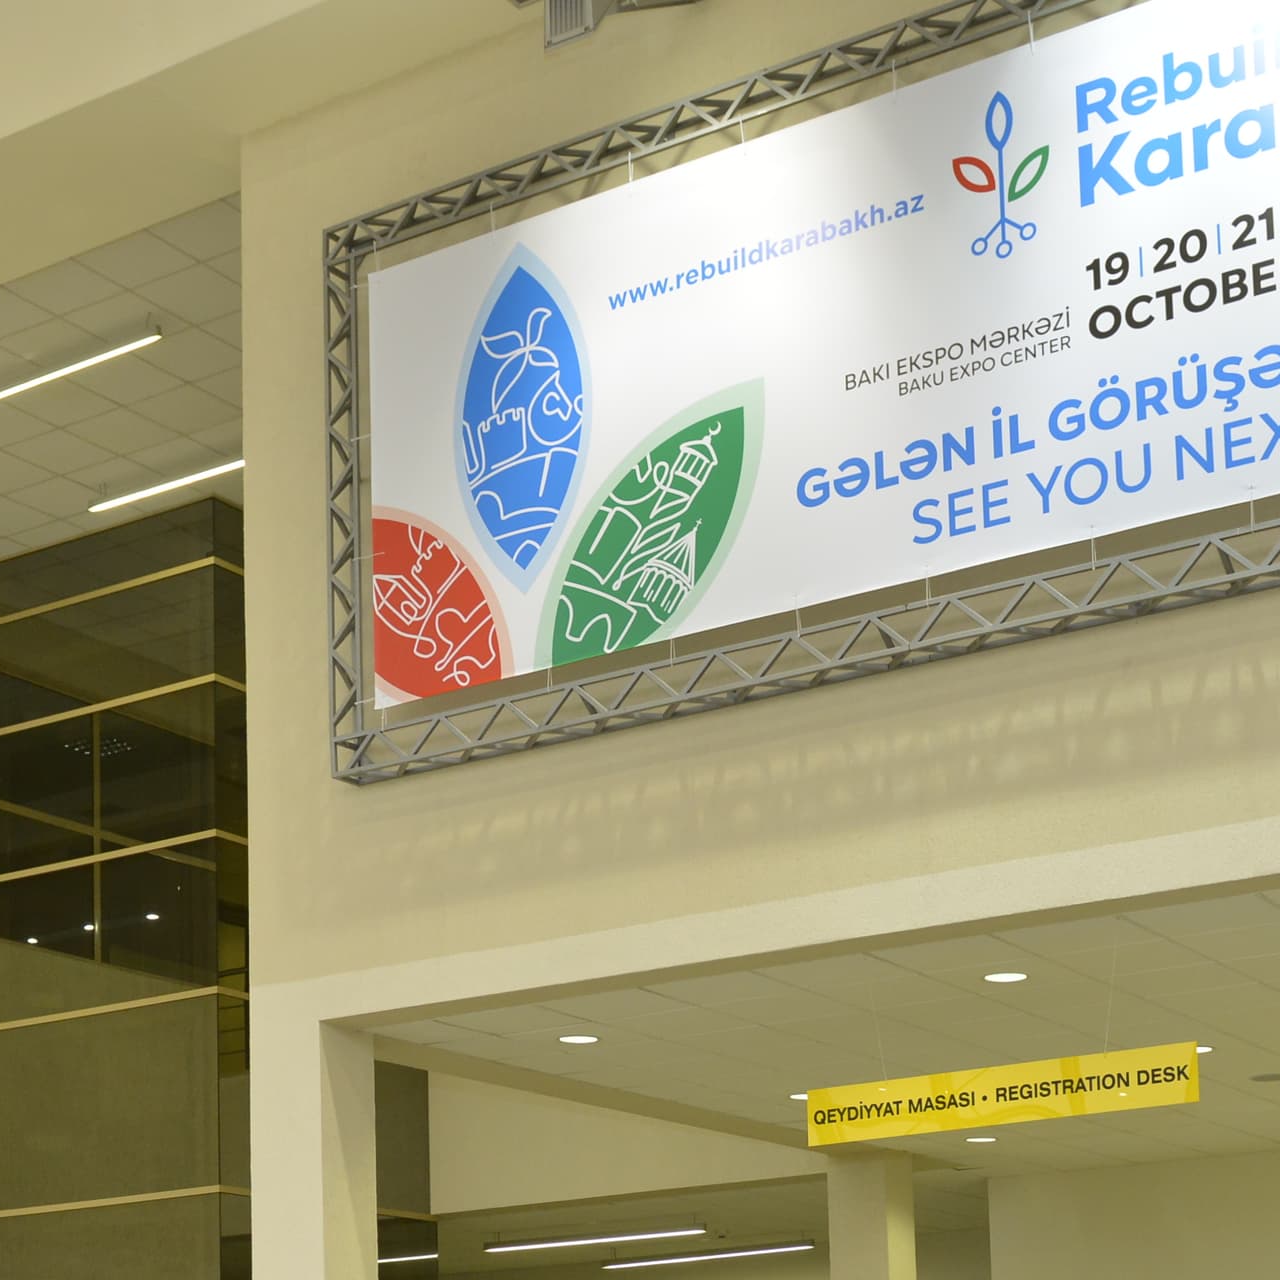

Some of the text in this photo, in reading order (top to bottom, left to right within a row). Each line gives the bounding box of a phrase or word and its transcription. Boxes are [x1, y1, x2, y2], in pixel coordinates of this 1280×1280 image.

[608, 193, 926, 310] www.rebuildkarabakh.az
[1085, 251, 1131, 291] 19
[1152, 228, 1209, 273] 20
[1231, 206, 1276, 250] 21
[845, 306, 1071, 391] BAKI EKSPO MƏRKƏZİ
[899, 335, 1071, 396] BAKU EXPO CENTER
[796, 426, 976, 508] GƏLƏN
[992, 406, 1036, 459] İL
[912, 478, 1012, 545] SEE
[1026, 442, 1153, 514] YOU
[813, 1064, 1190, 1126] QEYDİYYAT MASASI REGISTRATION DESK
